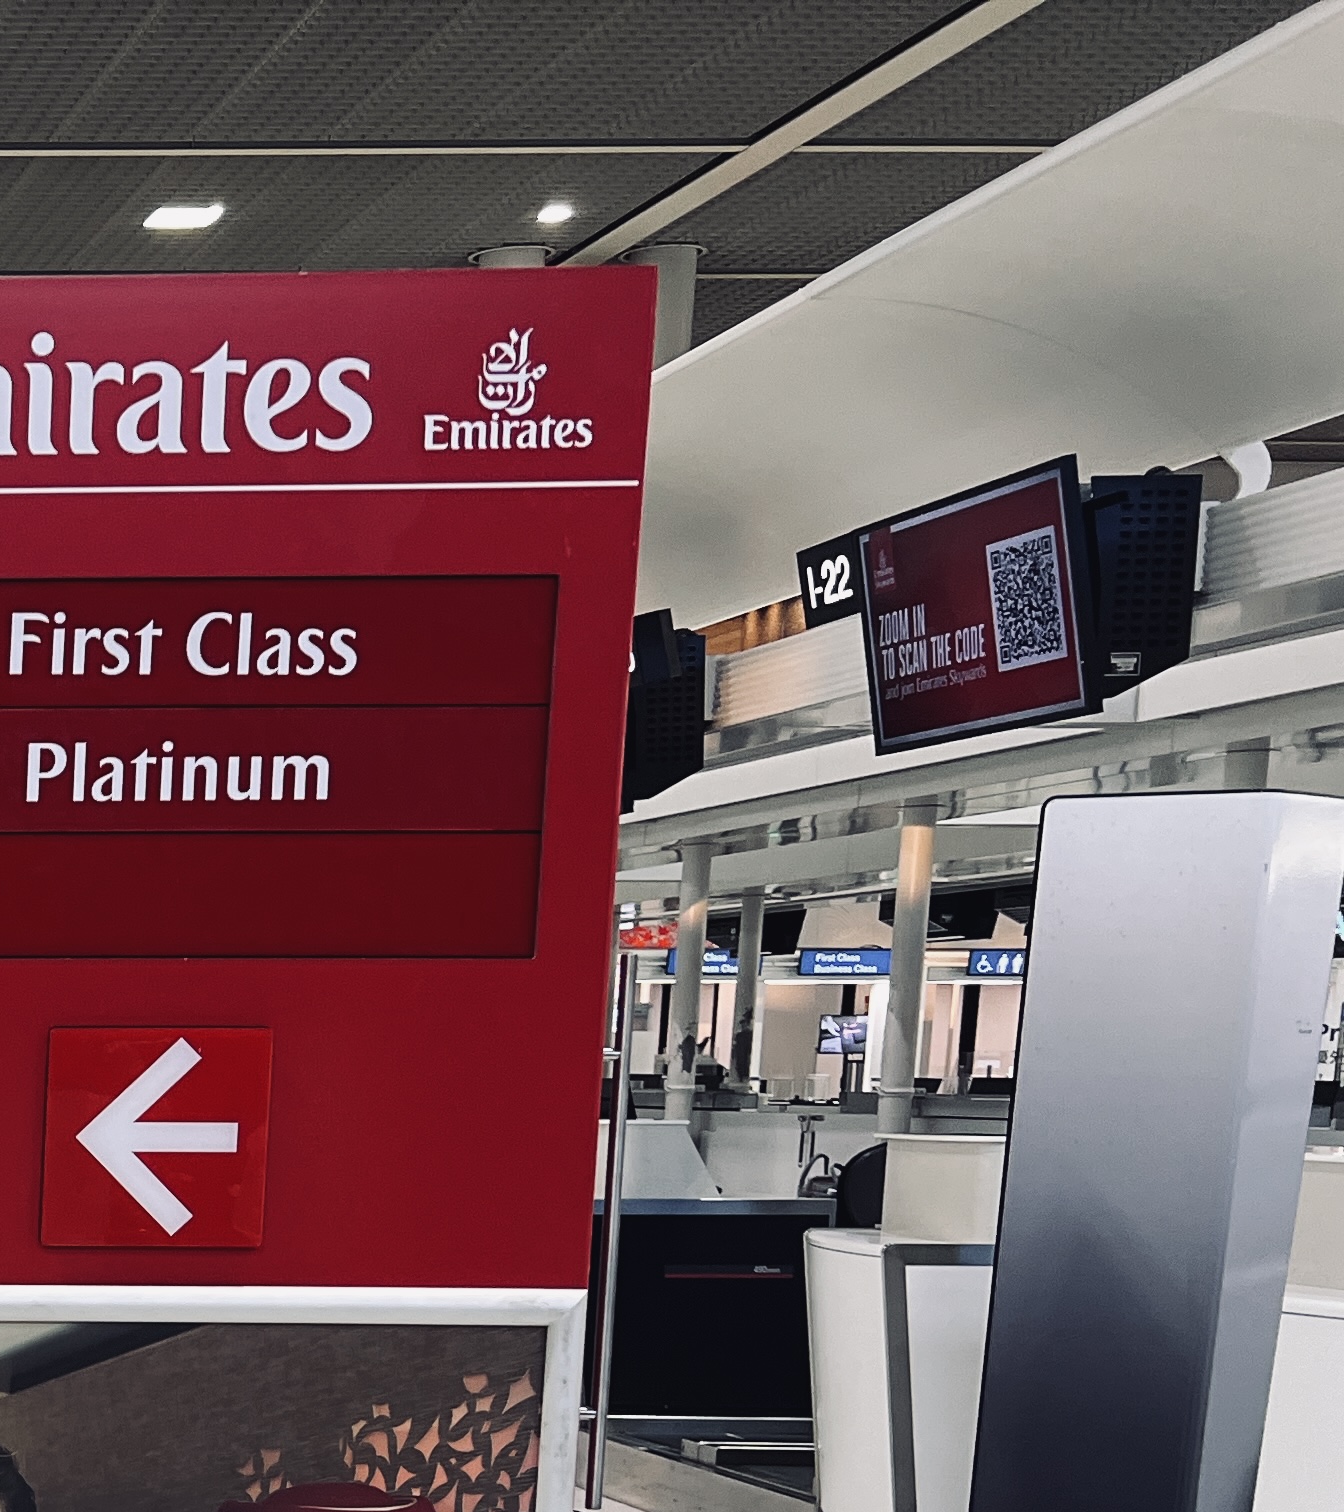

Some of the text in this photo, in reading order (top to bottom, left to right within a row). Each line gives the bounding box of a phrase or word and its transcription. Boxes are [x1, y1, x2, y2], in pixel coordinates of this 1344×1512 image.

[423, 411, 593, 451] Emirates
[806, 554, 854, 609] I-22
[8, 611, 359, 677] First Class
[879, 603, 925, 647] ZOOM IN
[882, 624, 986, 680] TO SCAN THE CODE
[24, 740, 330, 803] Platinum
